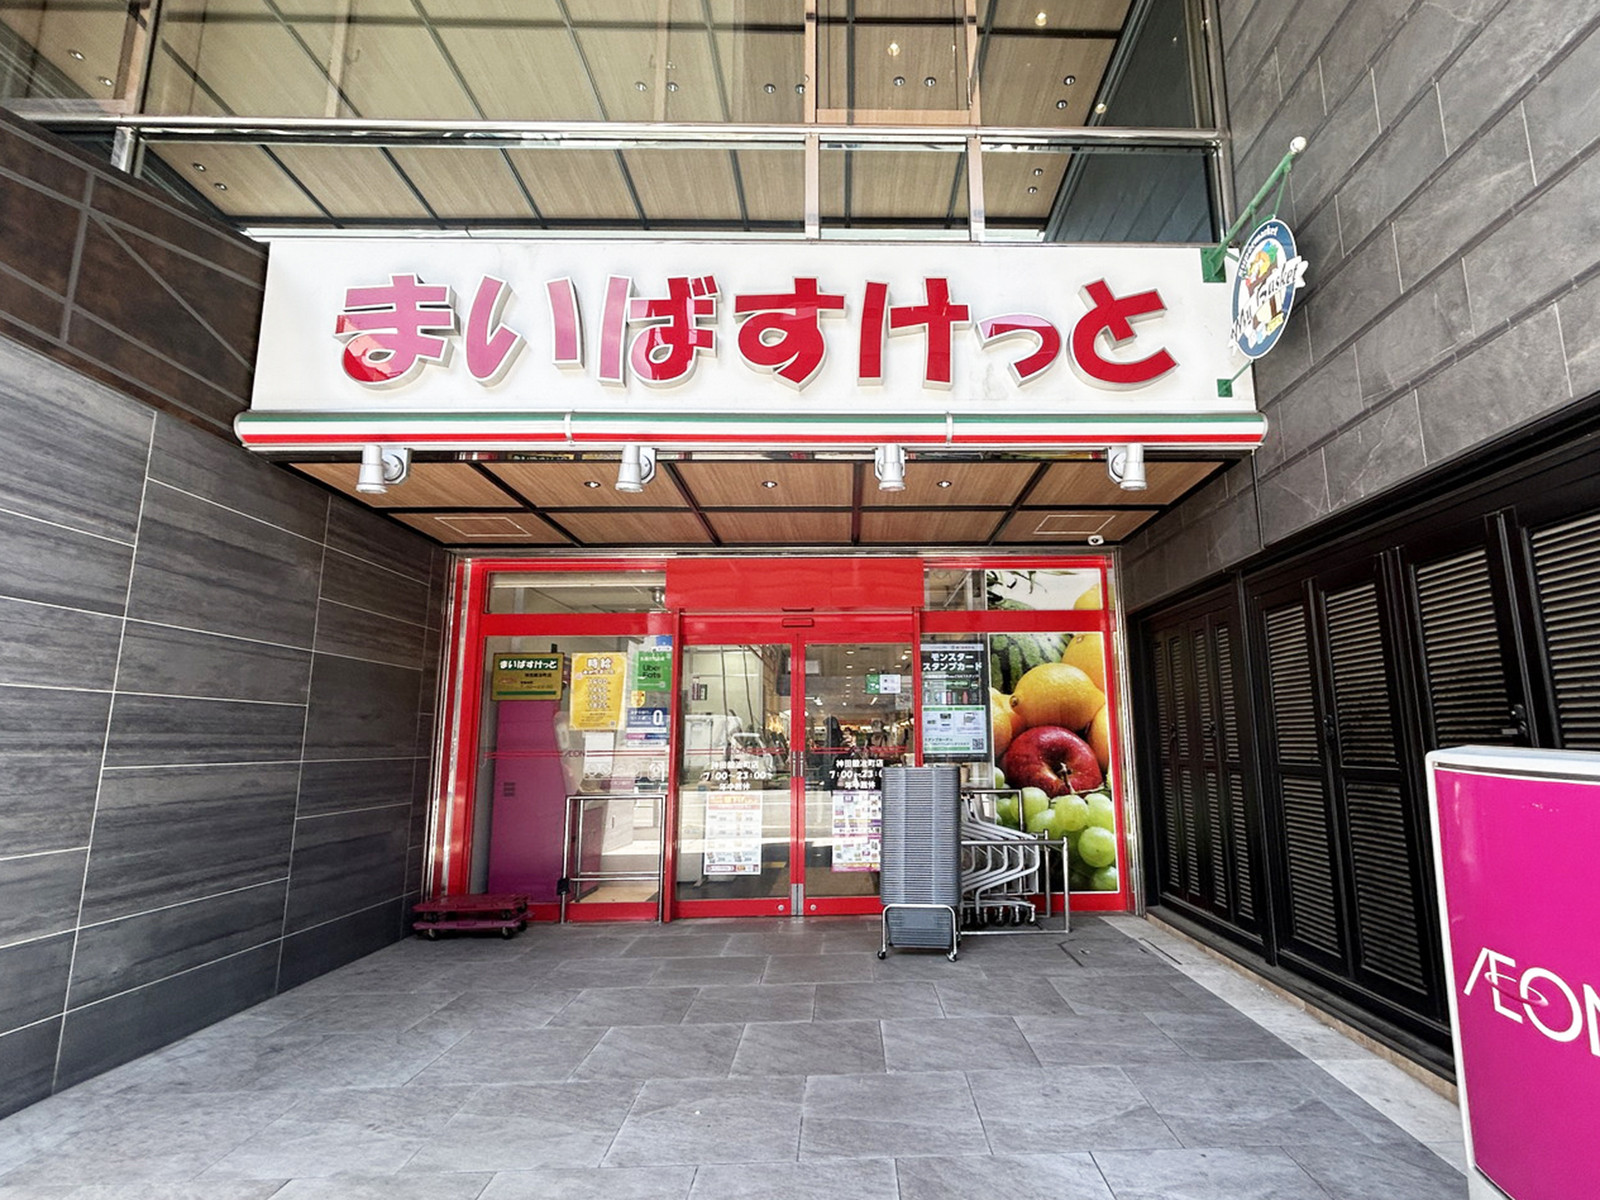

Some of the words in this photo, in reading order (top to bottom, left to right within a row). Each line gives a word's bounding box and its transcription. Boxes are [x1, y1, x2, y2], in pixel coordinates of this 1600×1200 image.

[334, 271, 1180, 390] まいばすけっと
[931, 653, 974, 661] モンスター
[499, 660, 557, 669] まいばすけっと
[922, 662, 982, 671] スタンプカード
